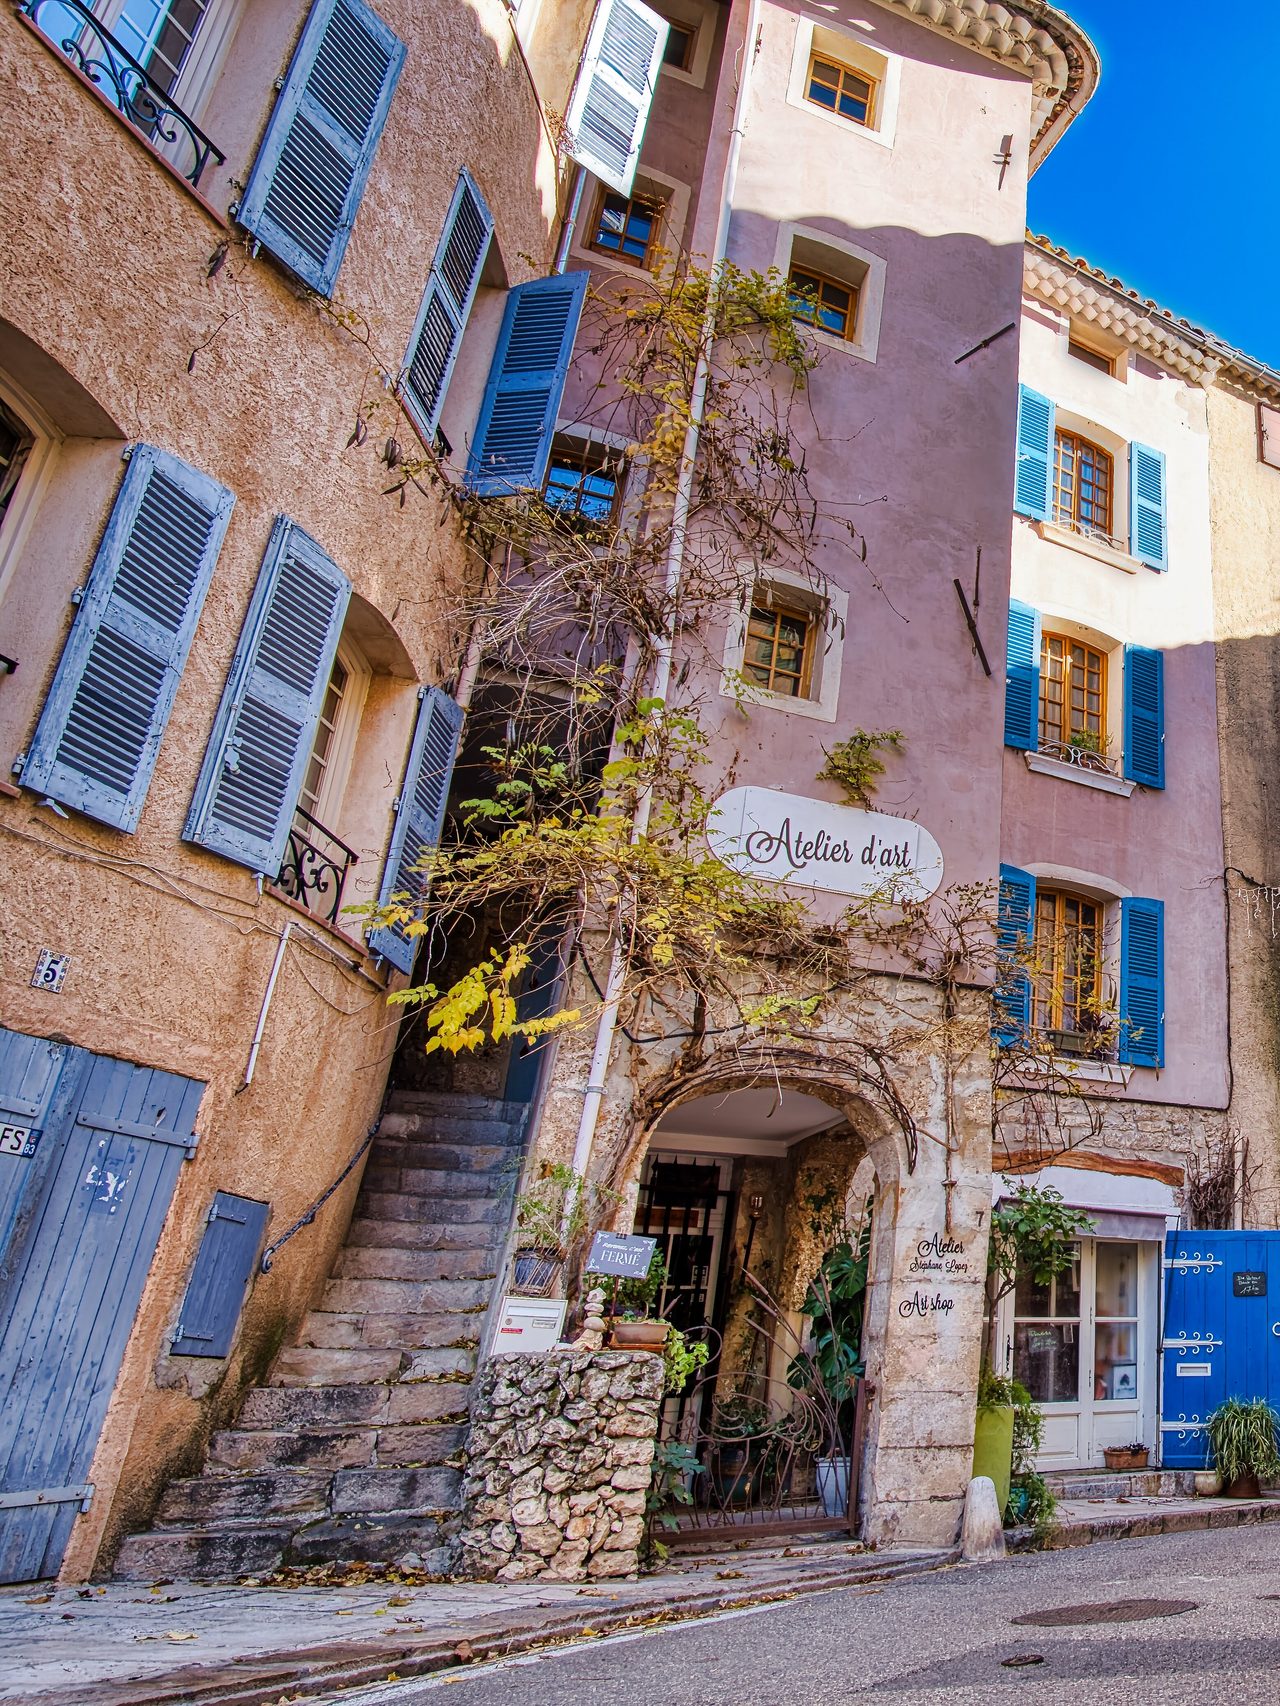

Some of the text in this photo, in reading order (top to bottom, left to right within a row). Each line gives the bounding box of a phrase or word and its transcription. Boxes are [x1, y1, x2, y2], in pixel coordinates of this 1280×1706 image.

[746, 817, 912, 869] Atelier d'art
[43, 959, 61, 983] 5
[24, 1143, 36, 1155] 83
[976, 1211, 985, 1227] 7
[917, 1232, 965, 1258] Atelier
[600, 1250, 641, 1266] FERMÉ
[899, 1291, 955, 1318] Art shop
